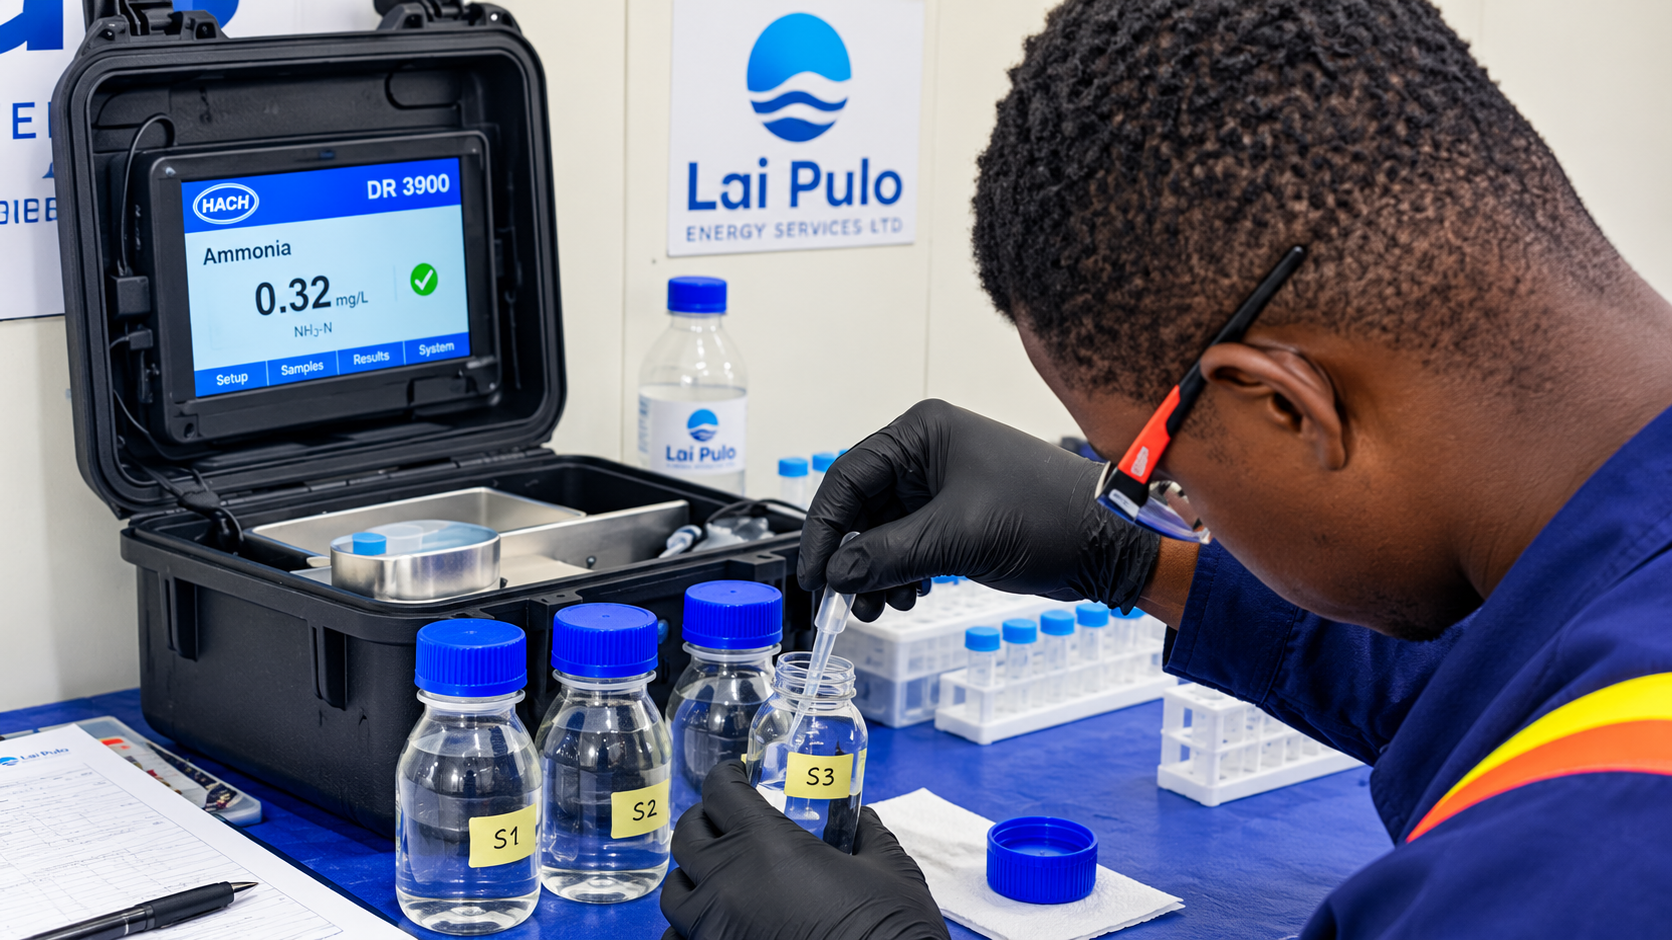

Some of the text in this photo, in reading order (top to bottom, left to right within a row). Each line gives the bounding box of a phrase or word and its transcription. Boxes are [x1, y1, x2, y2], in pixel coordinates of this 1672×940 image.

[367, 173, 450, 200] DR 3900
[688, 157, 903, 210] Lai Pulo
[202, 195, 250, 213] HACH
[686, 216, 903, 242] ENERGY SERVICES LTD
[203, 240, 291, 266] Ammonia
[255, 275, 368, 316] 0.32 mg/L
[353, 351, 390, 366] Results
[419, 341, 455, 357] System
[281, 361, 324, 377] Samples
[216, 373, 249, 387] Setup
[666, 444, 736, 462] Lai Pulo
[805, 767, 836, 786] S3
[632, 799, 658, 821] S2
[493, 827, 520, 850] S1
